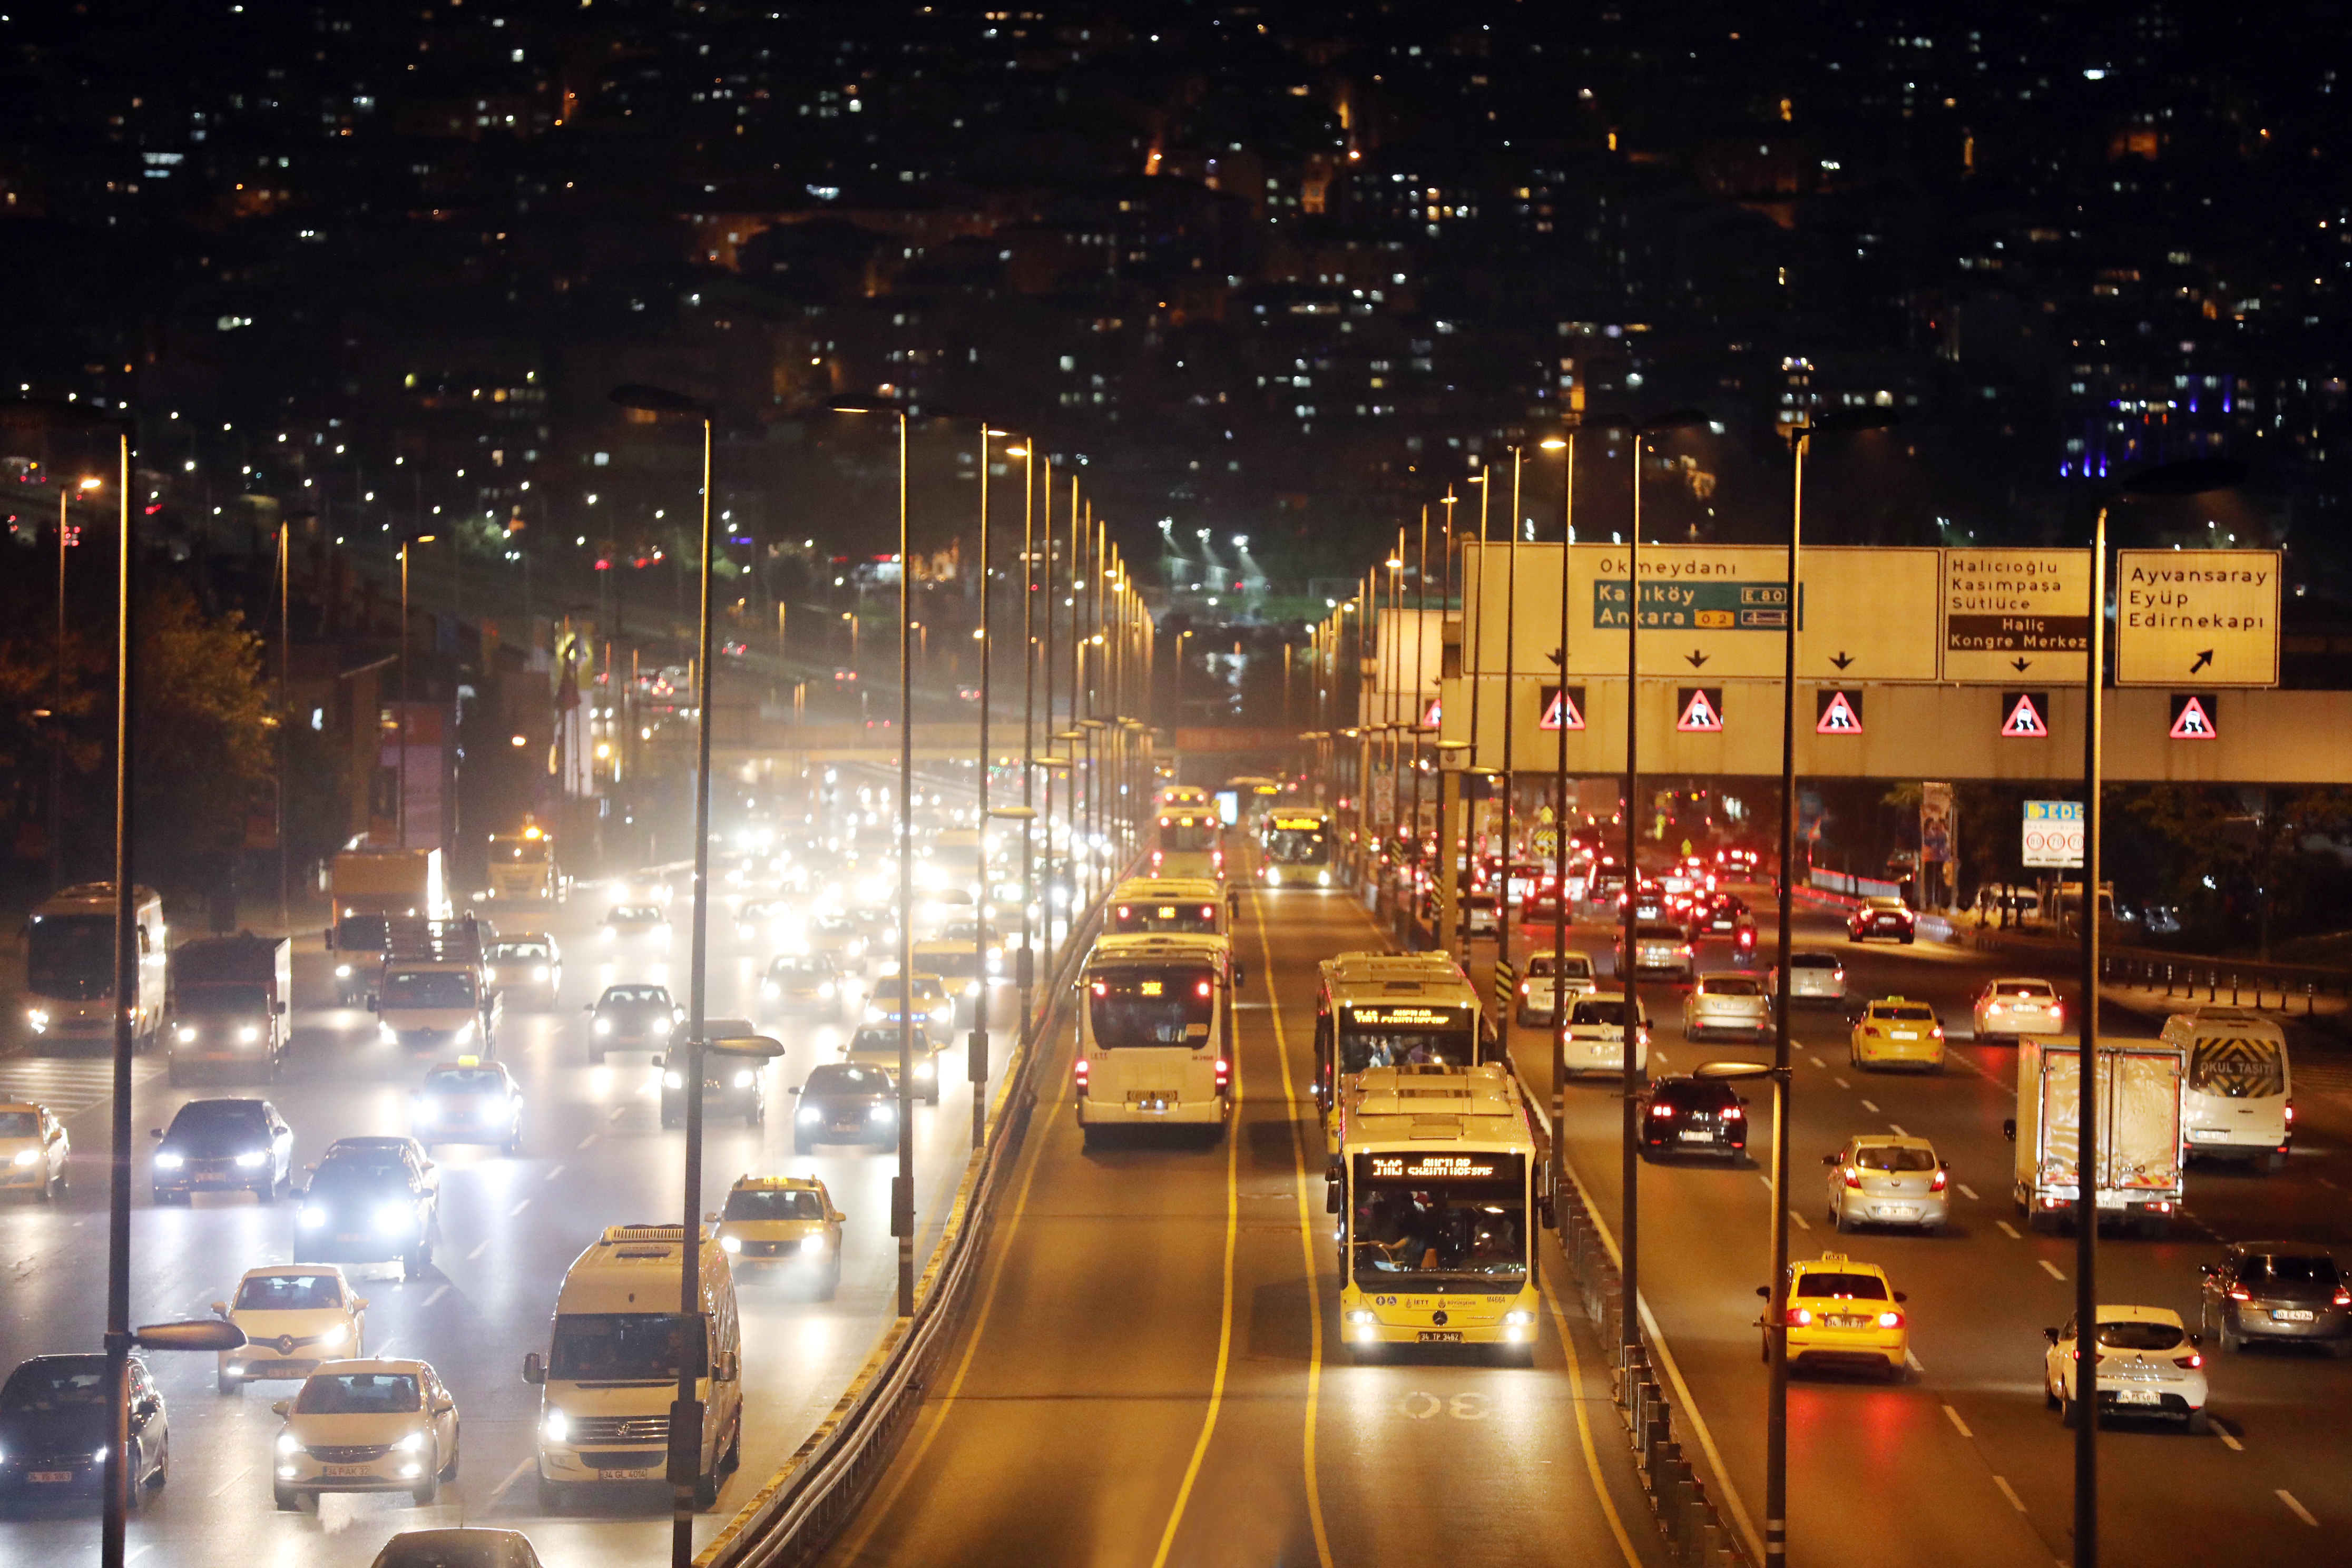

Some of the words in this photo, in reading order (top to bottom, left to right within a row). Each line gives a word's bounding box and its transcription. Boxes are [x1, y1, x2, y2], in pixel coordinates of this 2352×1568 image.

[1953, 560, 2057, 575] Halıcıoğlu
[2131, 567, 2267, 586] Ayvansaray
[1953, 578, 2061, 593] Kasımpaşa
[1953, 597, 2030, 610] Sütlüce
[2130, 590, 2188, 607] Eyüp
[1599, 607, 1684, 625] Ankara
[2130, 612, 2264, 631] Edirnekapı
[2003, 619, 2045, 633] Haliç
[1951, 635, 2014, 651] Kongre
[2049, 804, 2083, 819] EDS
[2200, 1061, 2233, 1074] OKUL
